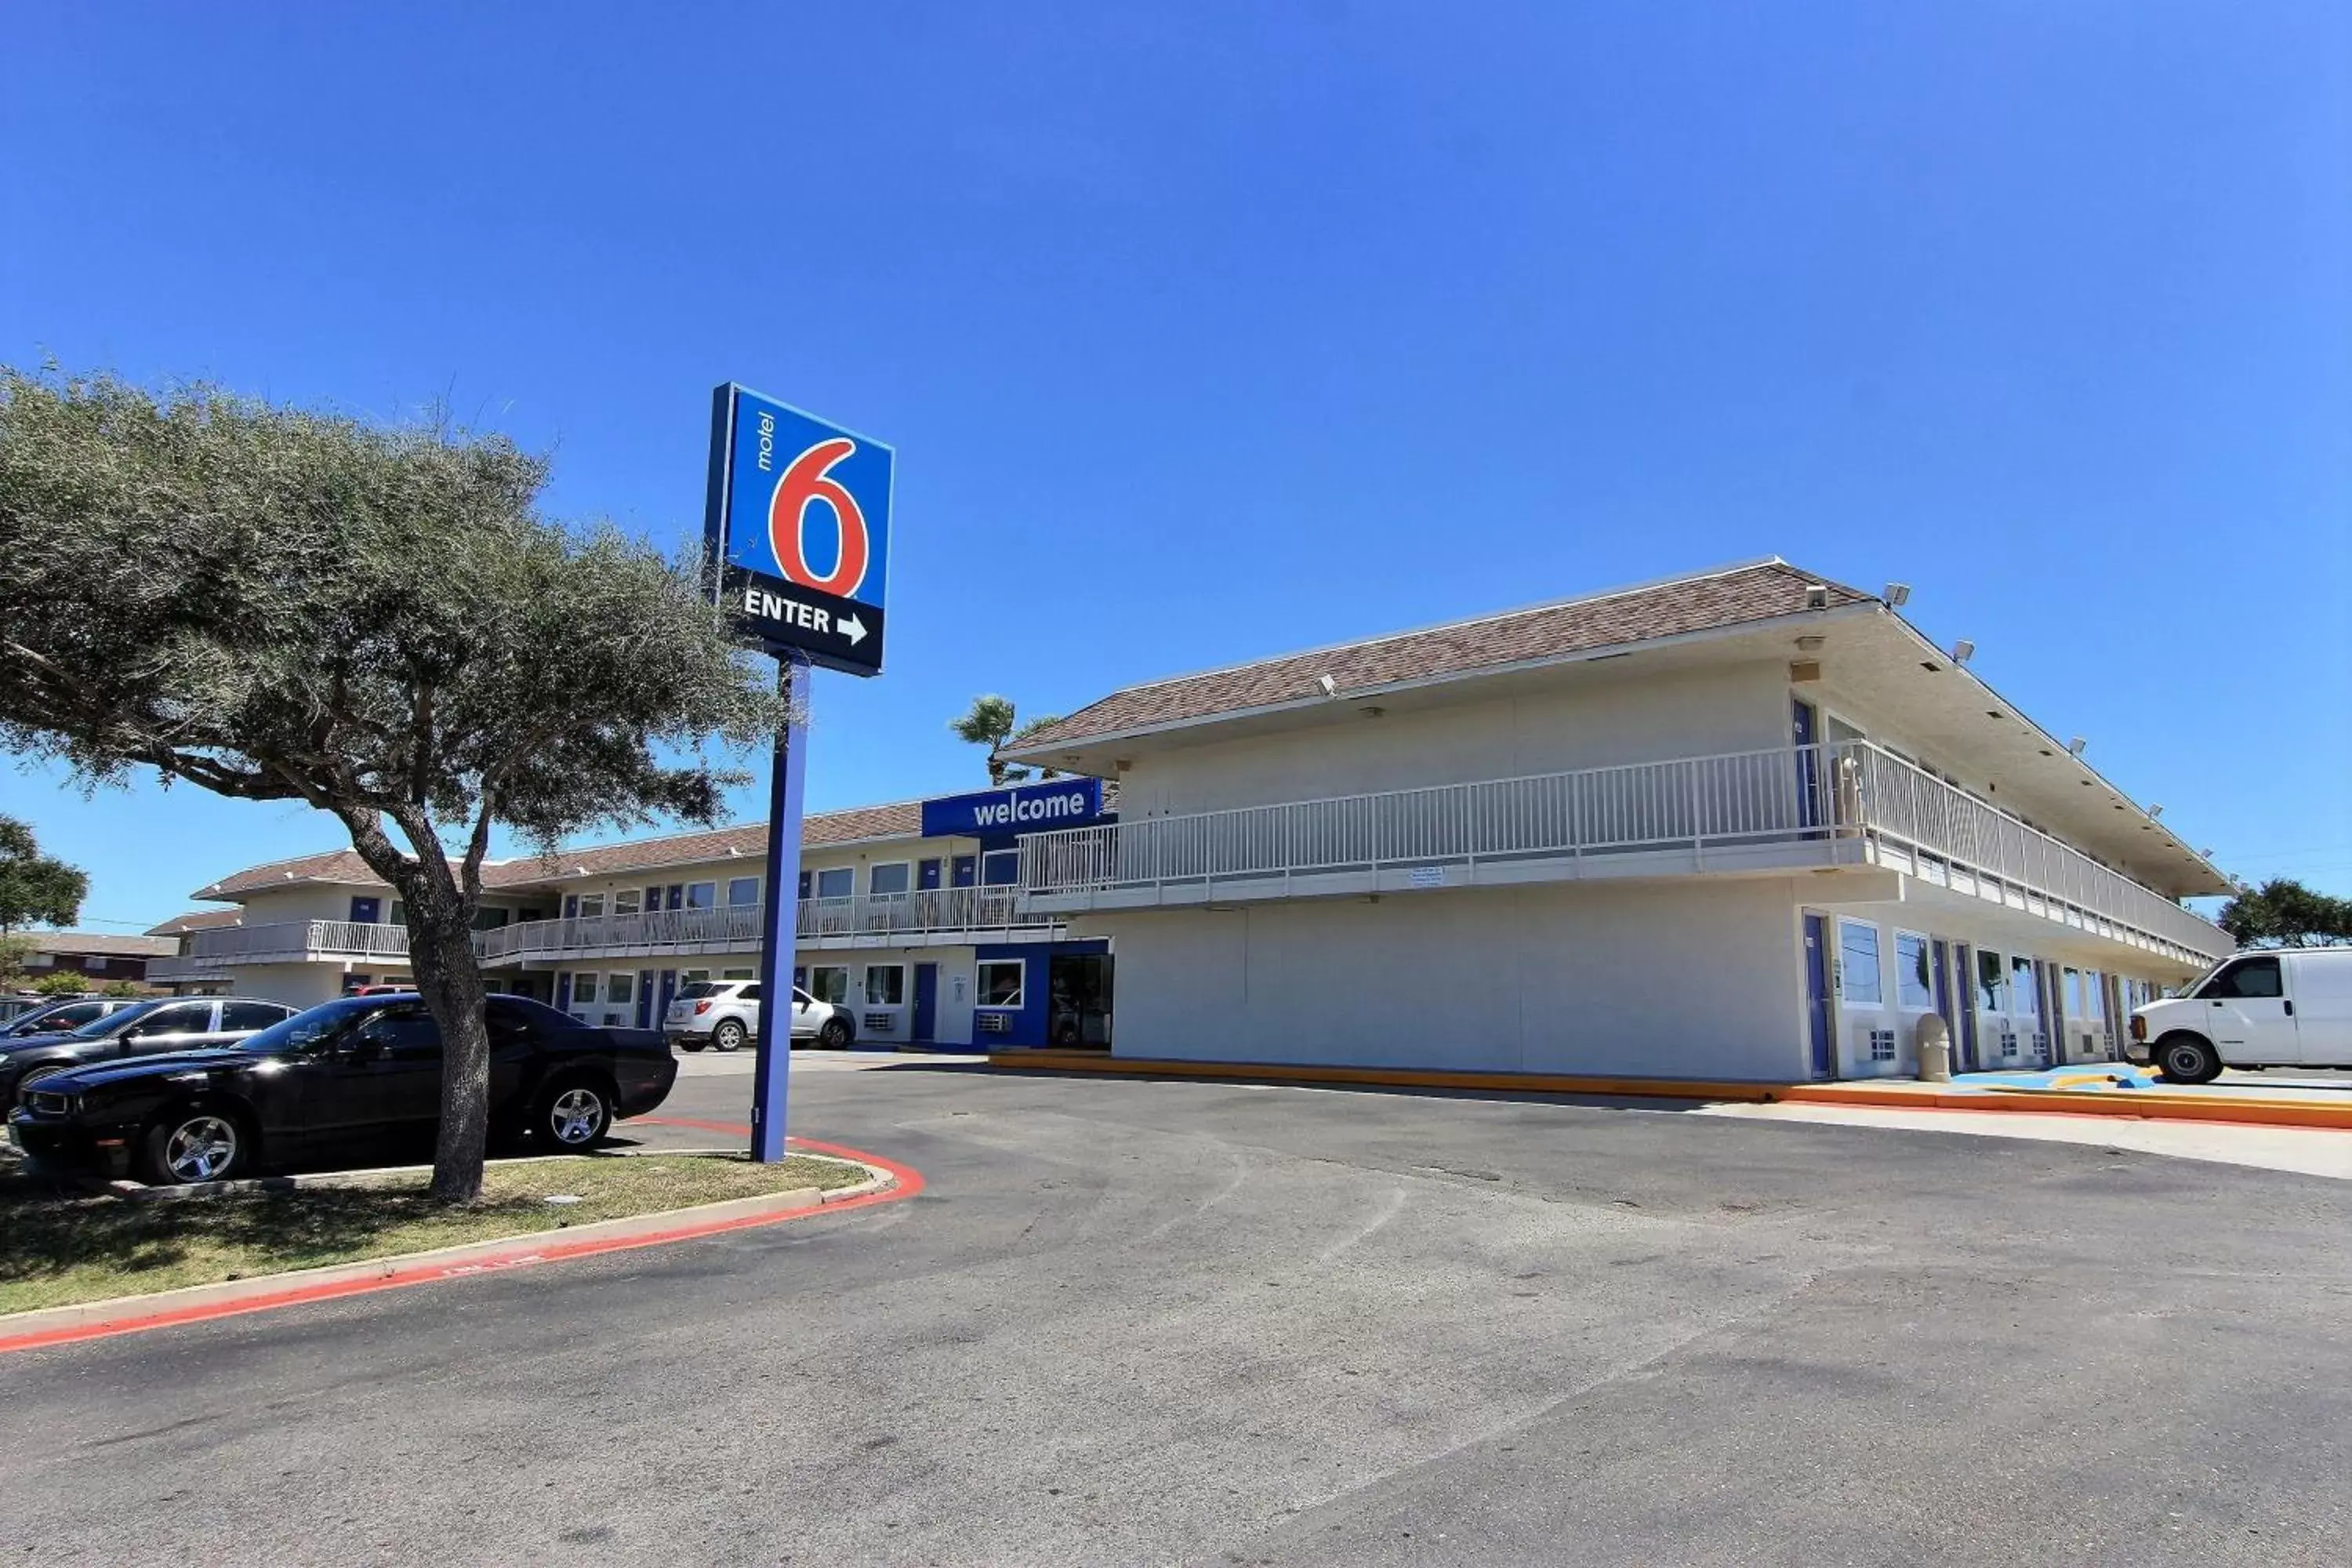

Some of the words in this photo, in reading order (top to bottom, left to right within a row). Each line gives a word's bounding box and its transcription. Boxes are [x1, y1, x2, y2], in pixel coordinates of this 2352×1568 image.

[757, 411, 775, 470] motel
[768, 437, 869, 597] 6
[745, 590, 829, 633] ENTER
[974, 792, 1084, 826] welcome
